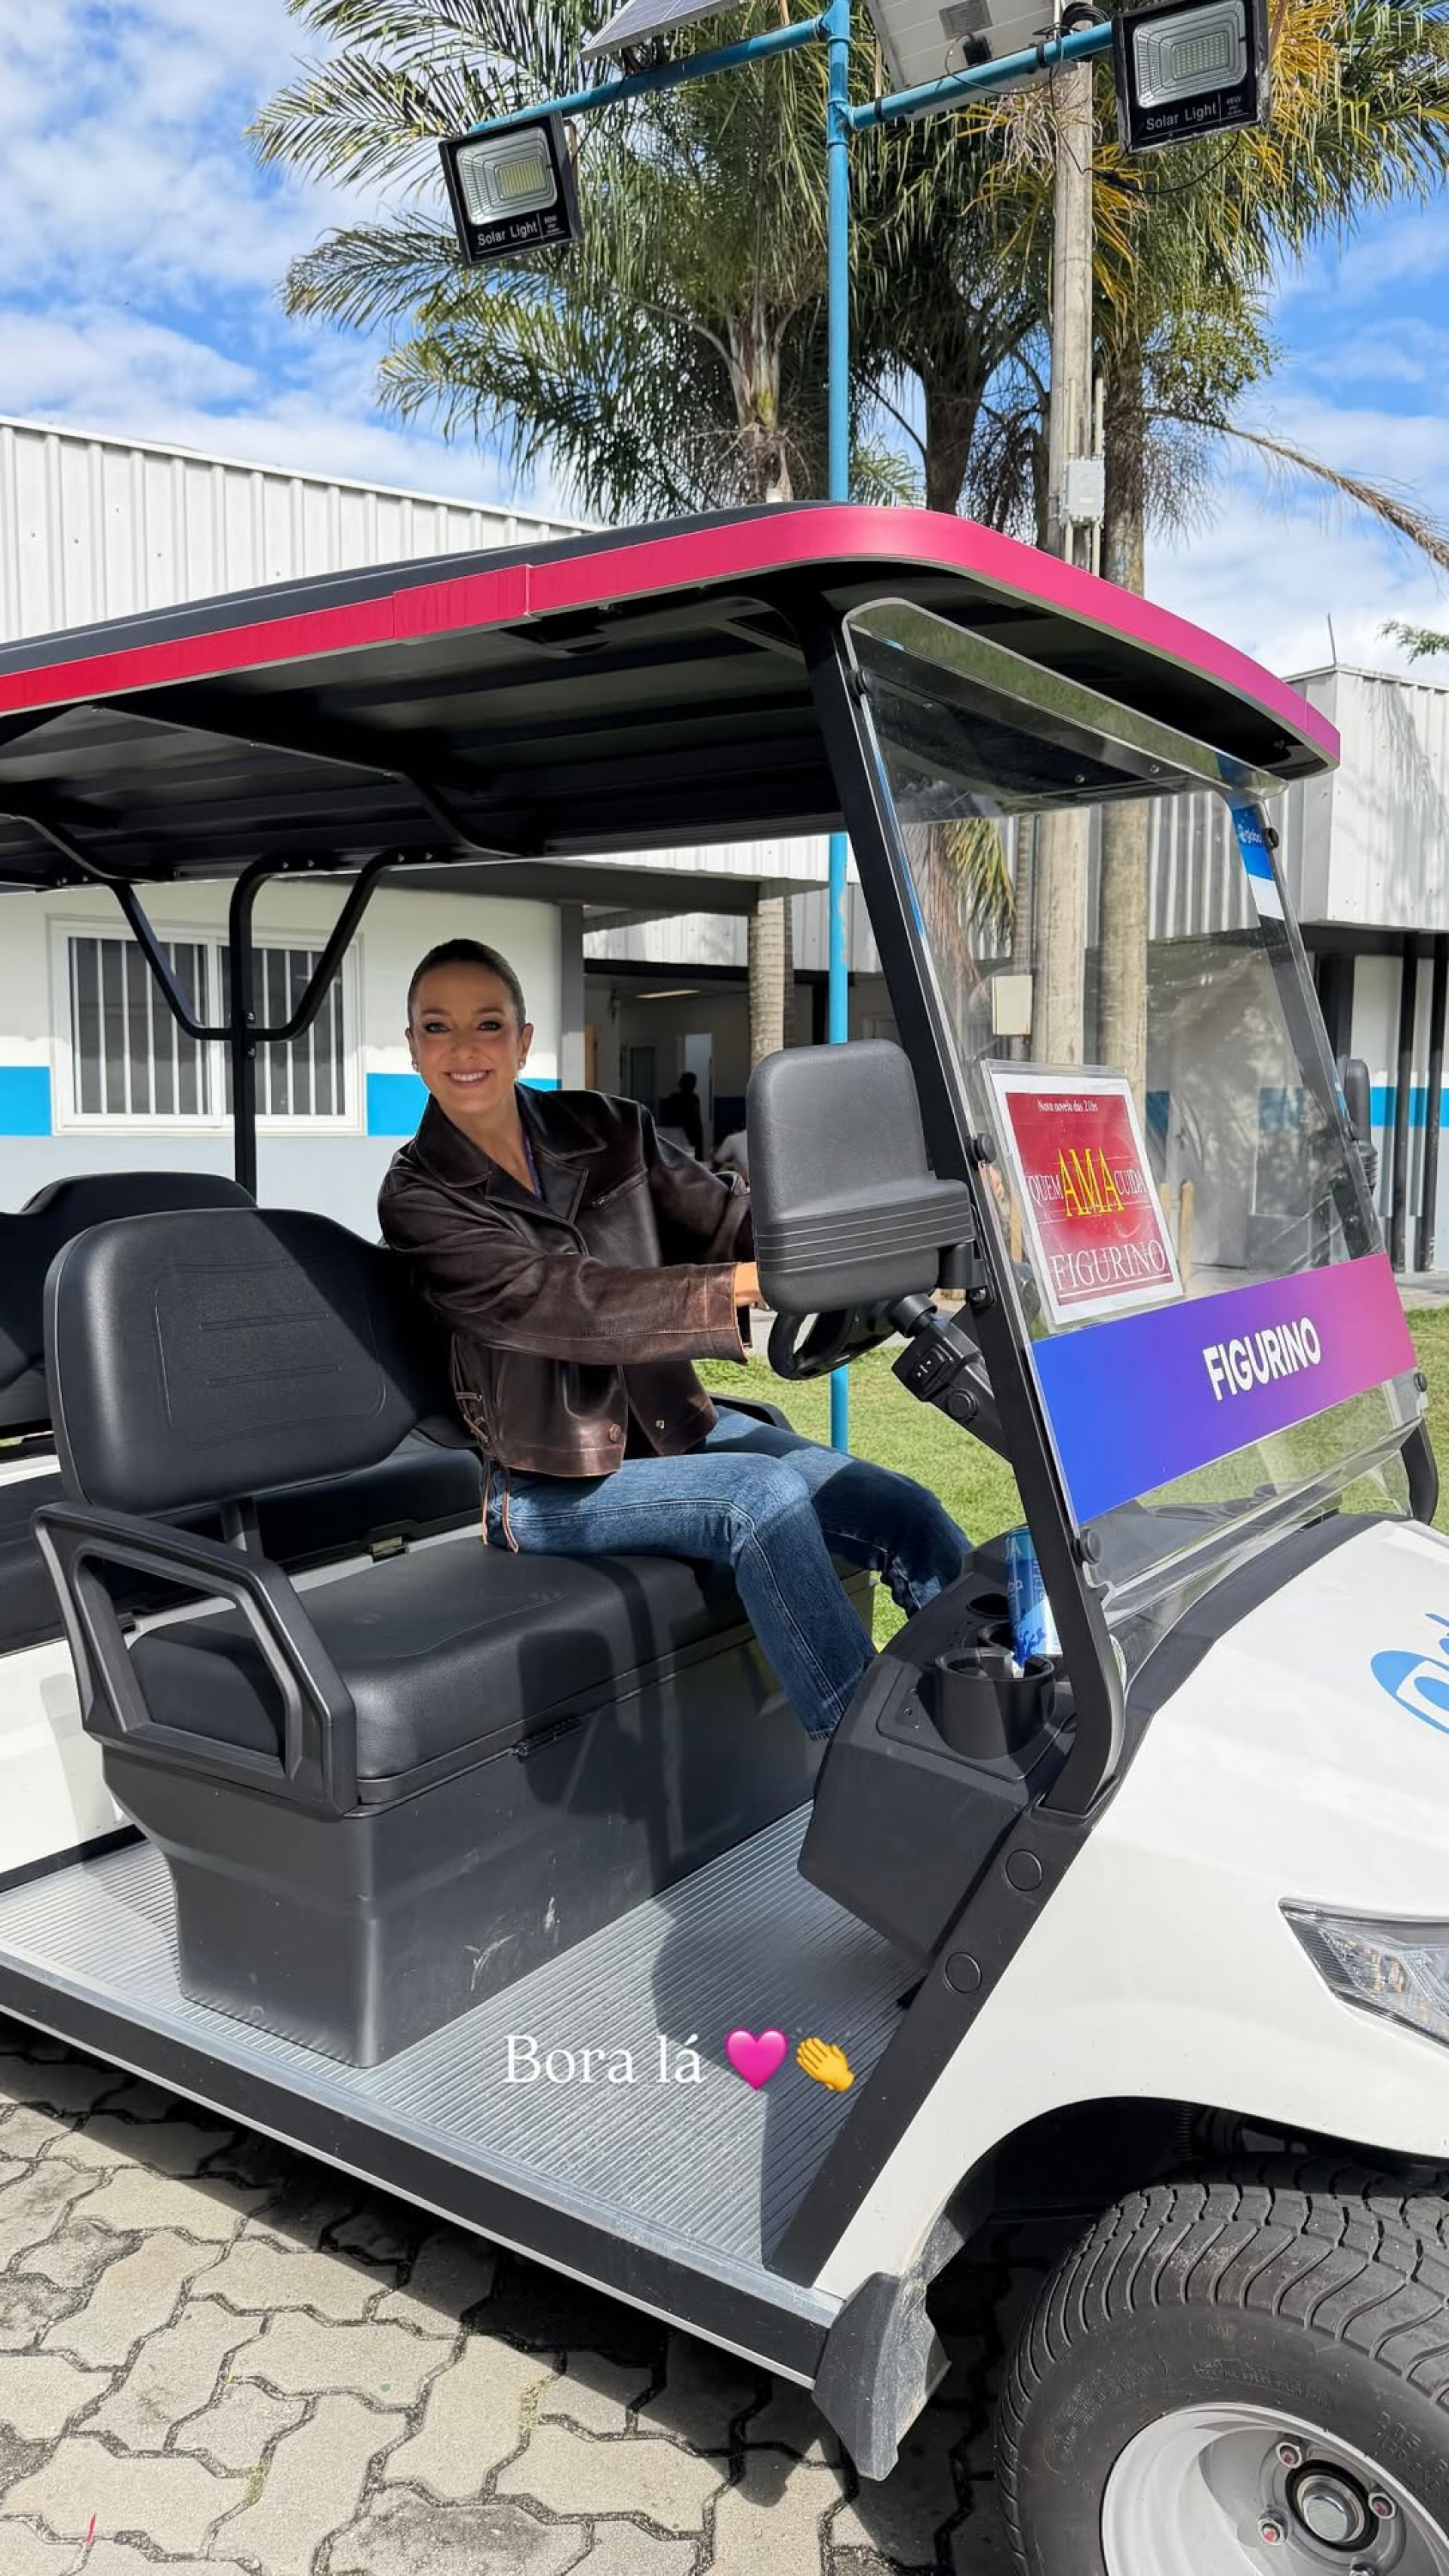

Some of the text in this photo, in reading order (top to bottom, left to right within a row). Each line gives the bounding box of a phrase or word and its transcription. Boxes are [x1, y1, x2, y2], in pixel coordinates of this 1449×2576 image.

[1146, 112, 1179, 131] Solar
[1184, 102, 1217, 121] Light
[477, 231, 506, 246] Solar
[509, 221, 537, 239] Light
[1026, 1146, 1147, 1217] QUEM AMA CUIDA
[1050, 1239, 1165, 1290] FIGURINO
[1202, 1317, 1321, 1401] FIGURINO
